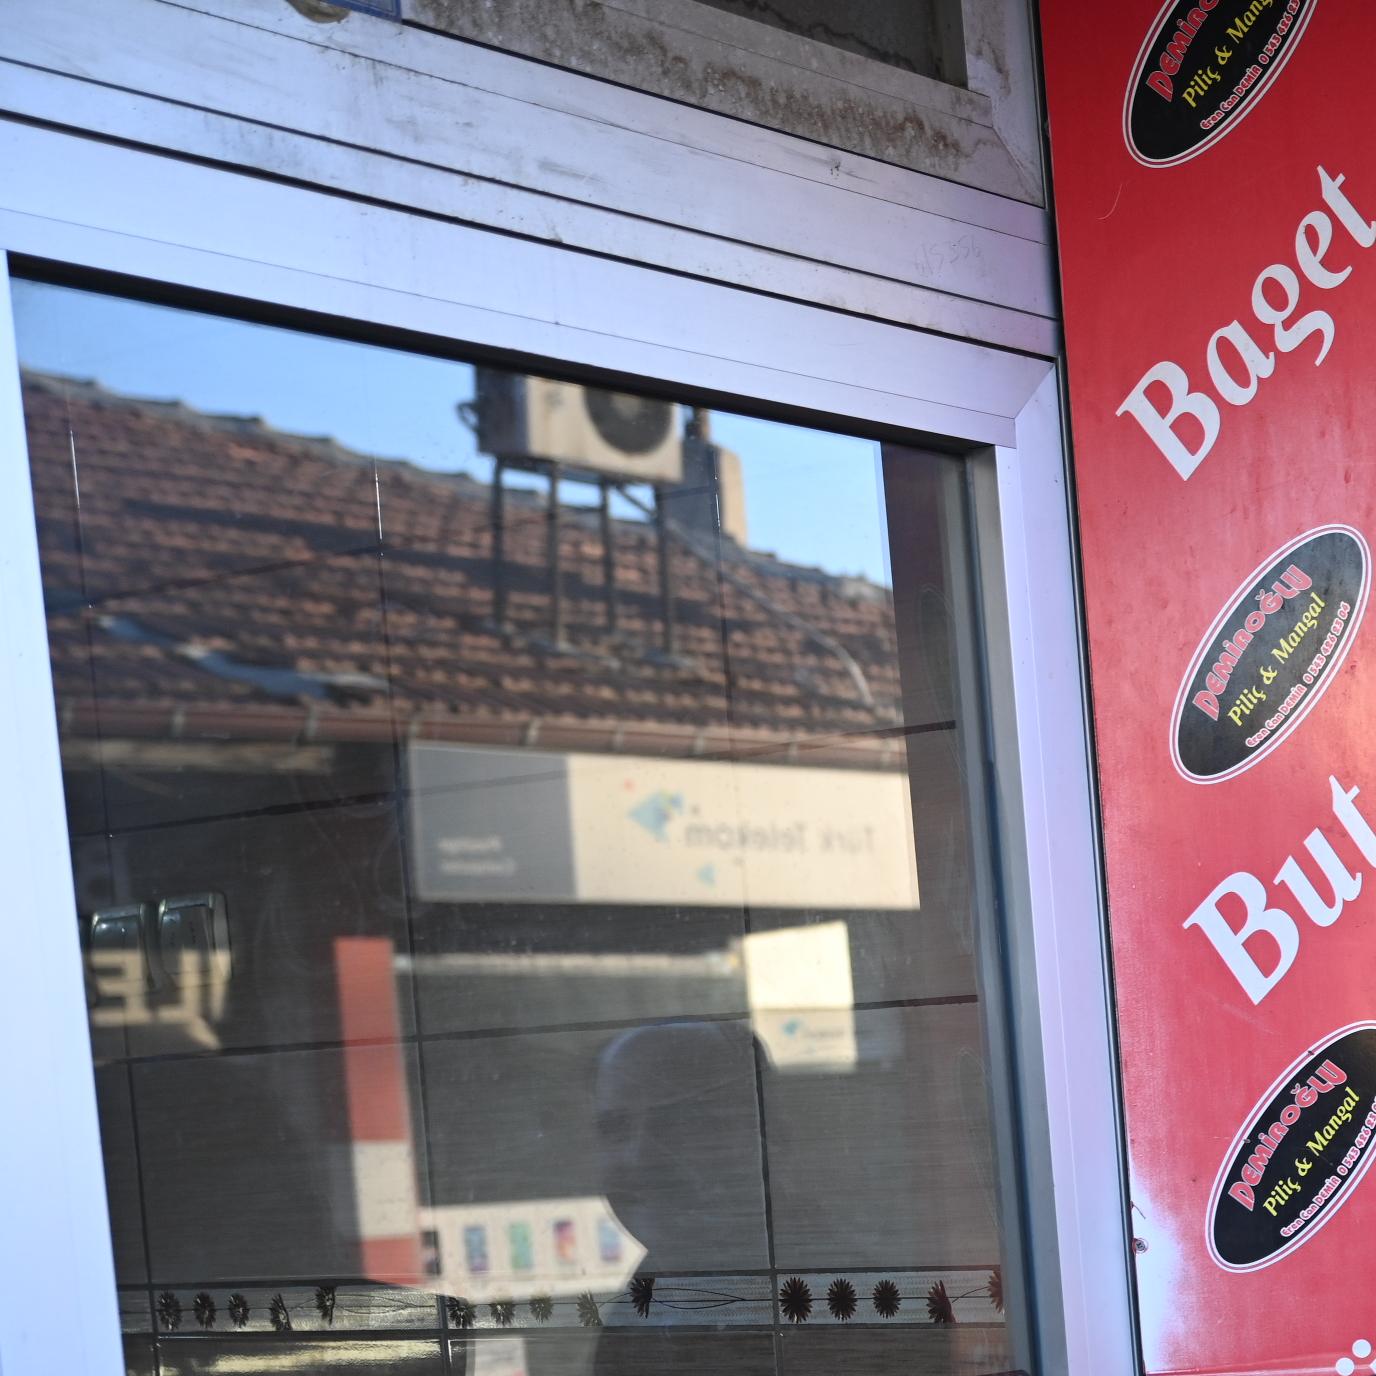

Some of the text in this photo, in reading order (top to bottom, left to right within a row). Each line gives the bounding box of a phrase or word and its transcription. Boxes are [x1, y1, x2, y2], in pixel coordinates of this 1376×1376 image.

[1182, 66, 1221, 107] Piliç
[1215, 45, 1232, 65] &
[1200, 109, 1224, 130] Eren
[1220, 94, 1239, 112] Can
[1233, 64, 1262, 96] DEMİR
[1258, 53, 1269, 65] 0
[1192, 564, 1313, 722] DEMİROĞLU
[1227, 592, 1326, 727] Piliç & Mangal
[1245, 727, 1269, 748] Eren
[1265, 711, 1285, 731] Can
[1278, 683, 1307, 716] DEMİR
[1303, 673, 1314, 685] 0
[1320, 634, 1337, 657] 426
[1338, 601, 1351, 619] 04
[1228, 1059, 1348, 1212] DEMİROĞLU
[1263, 1086, 1360, 1217] Piliç & Mangal
[1280, 1218, 1305, 1238] Eren
[1300, 1202, 1320, 1221] Can
[1312, 1173, 1342, 1207] DEMİR
[1337, 1165, 1348, 1177] 0
[1354, 1125, 1372, 1149] 426
